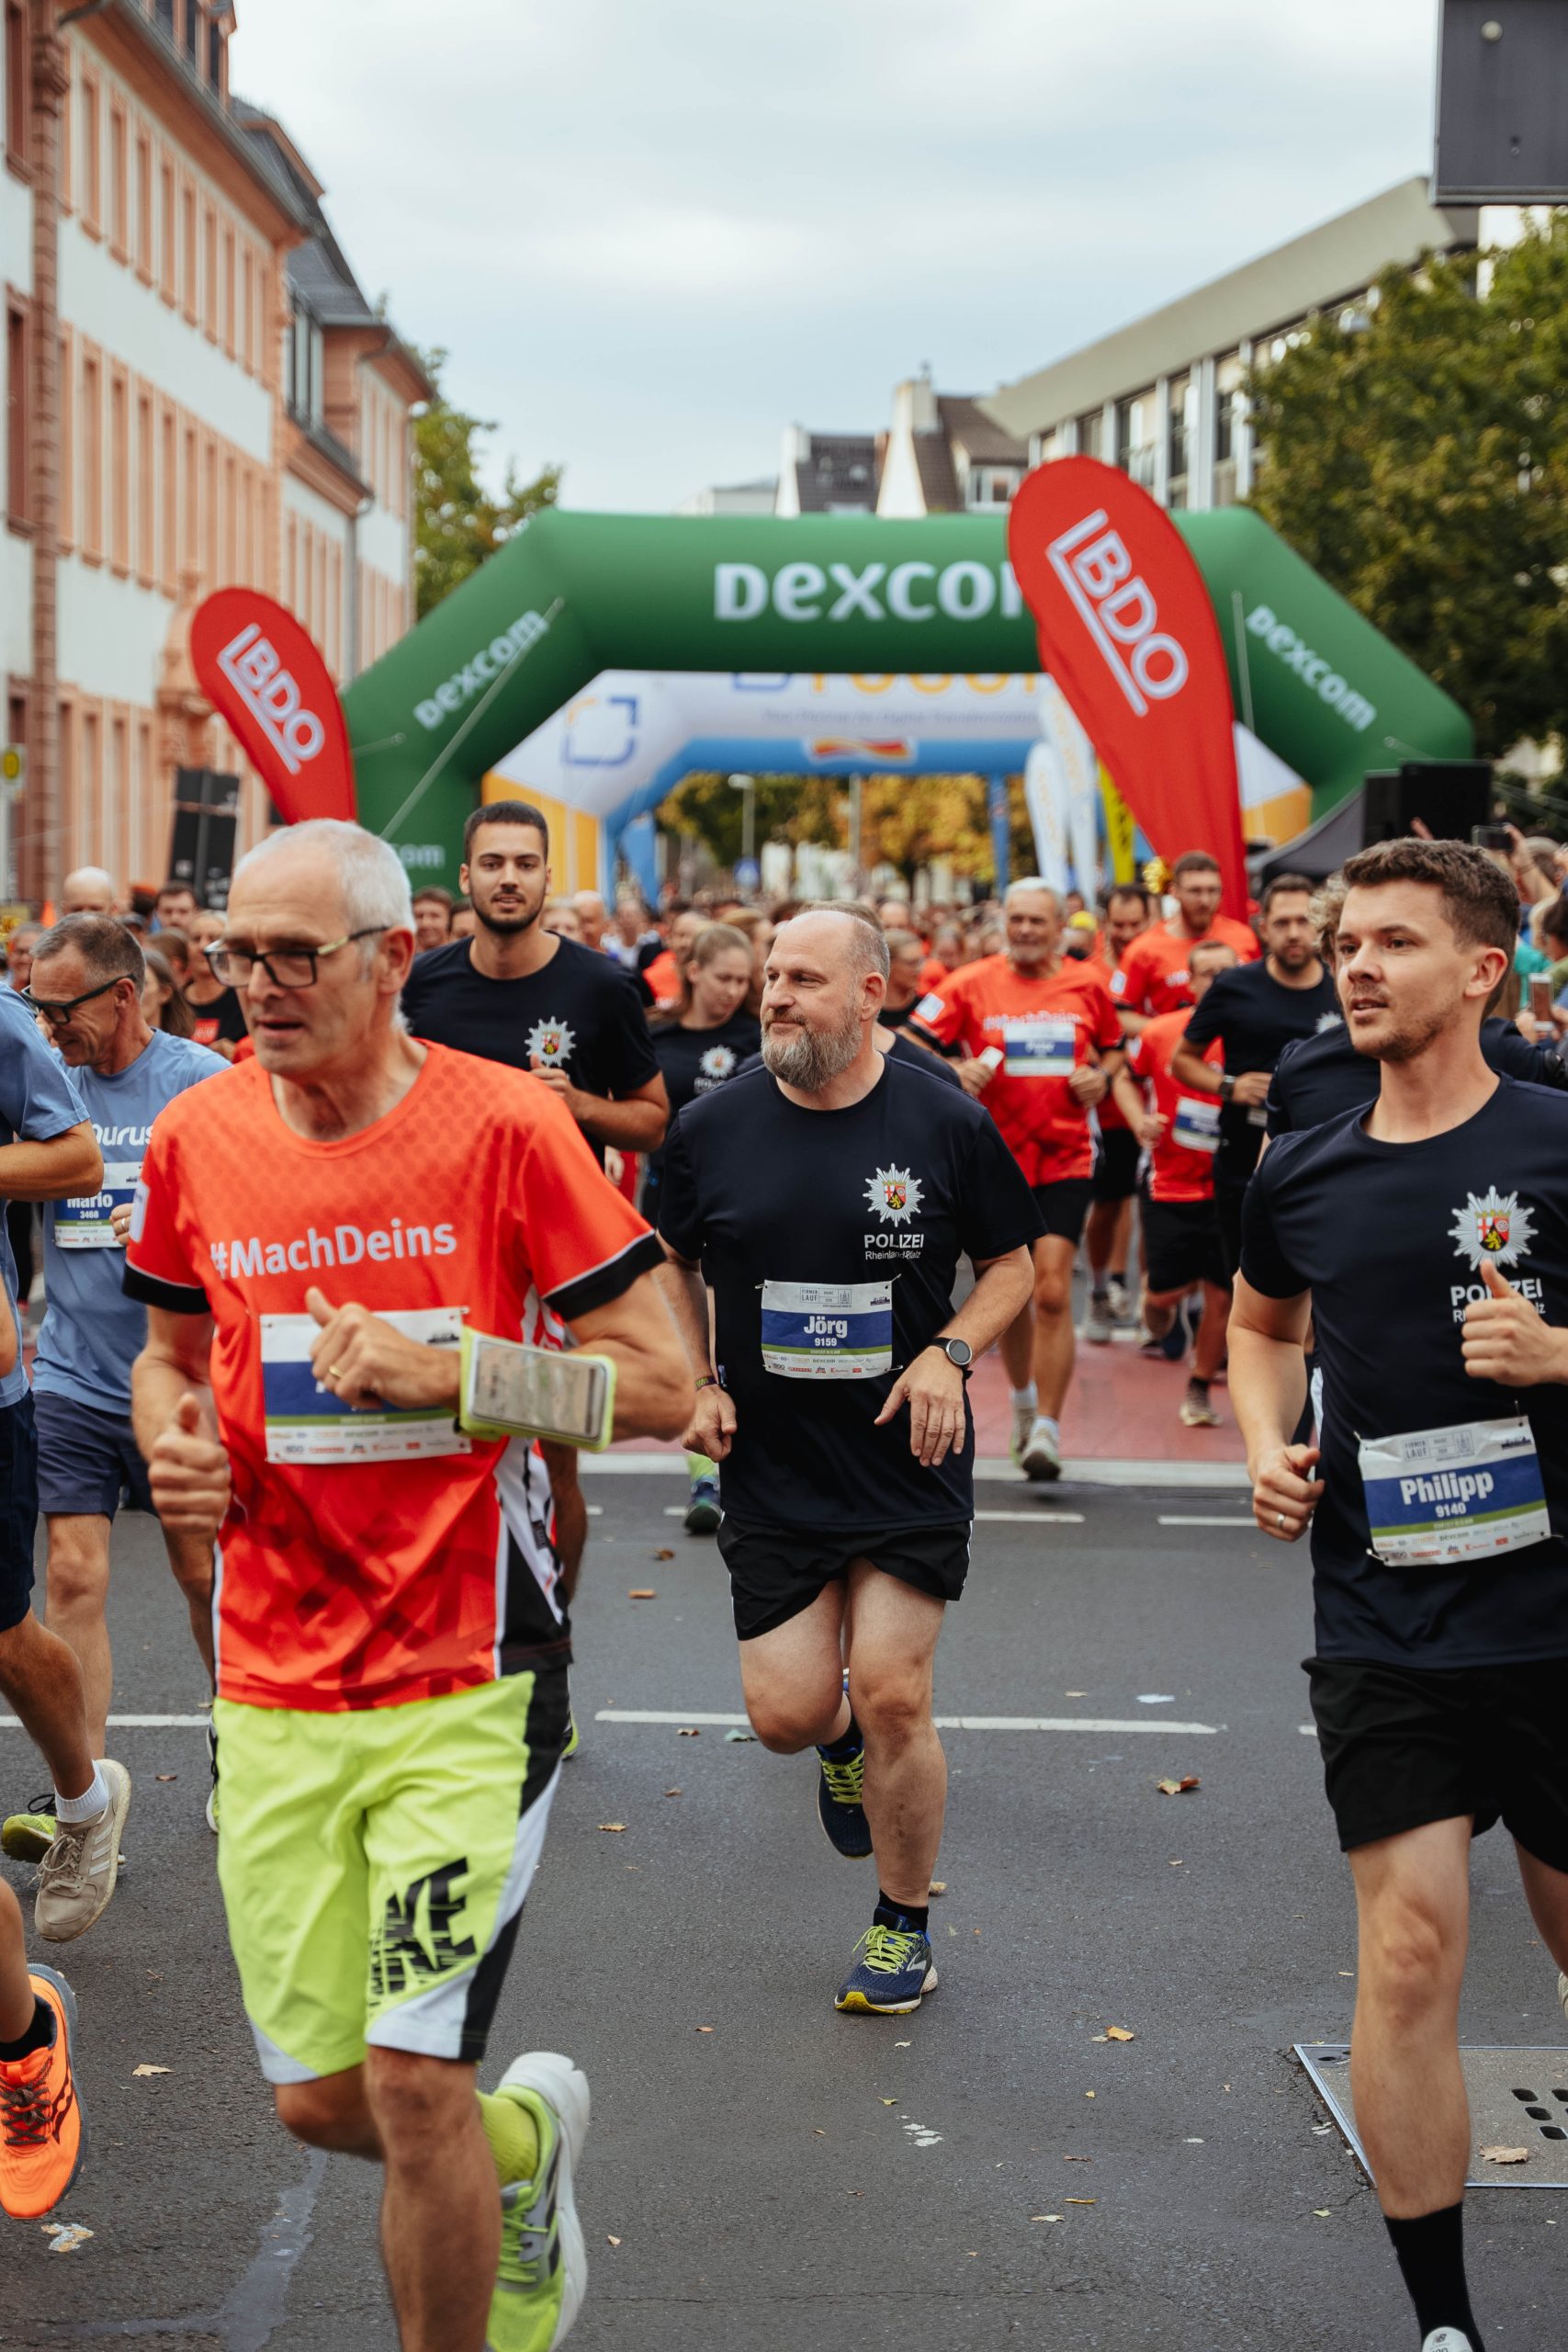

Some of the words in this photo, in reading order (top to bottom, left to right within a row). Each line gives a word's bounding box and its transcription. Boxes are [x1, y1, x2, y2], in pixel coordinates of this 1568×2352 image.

[1072, 528, 1189, 701] BDO
[412, 609, 550, 731] Dexcom
[1246, 603, 1377, 732] Dexcom
[235, 636, 326, 762] BDO
[210, 1217, 457, 1279] #MachDeins
[863, 1233, 924, 1249] POLIZEI
[804, 1316, 848, 1338] Jörg
[814, 1338, 837, 1347] 9159
[1399, 1471, 1495, 1506] Philipp
[1435, 1502, 1468, 1518] 9140
